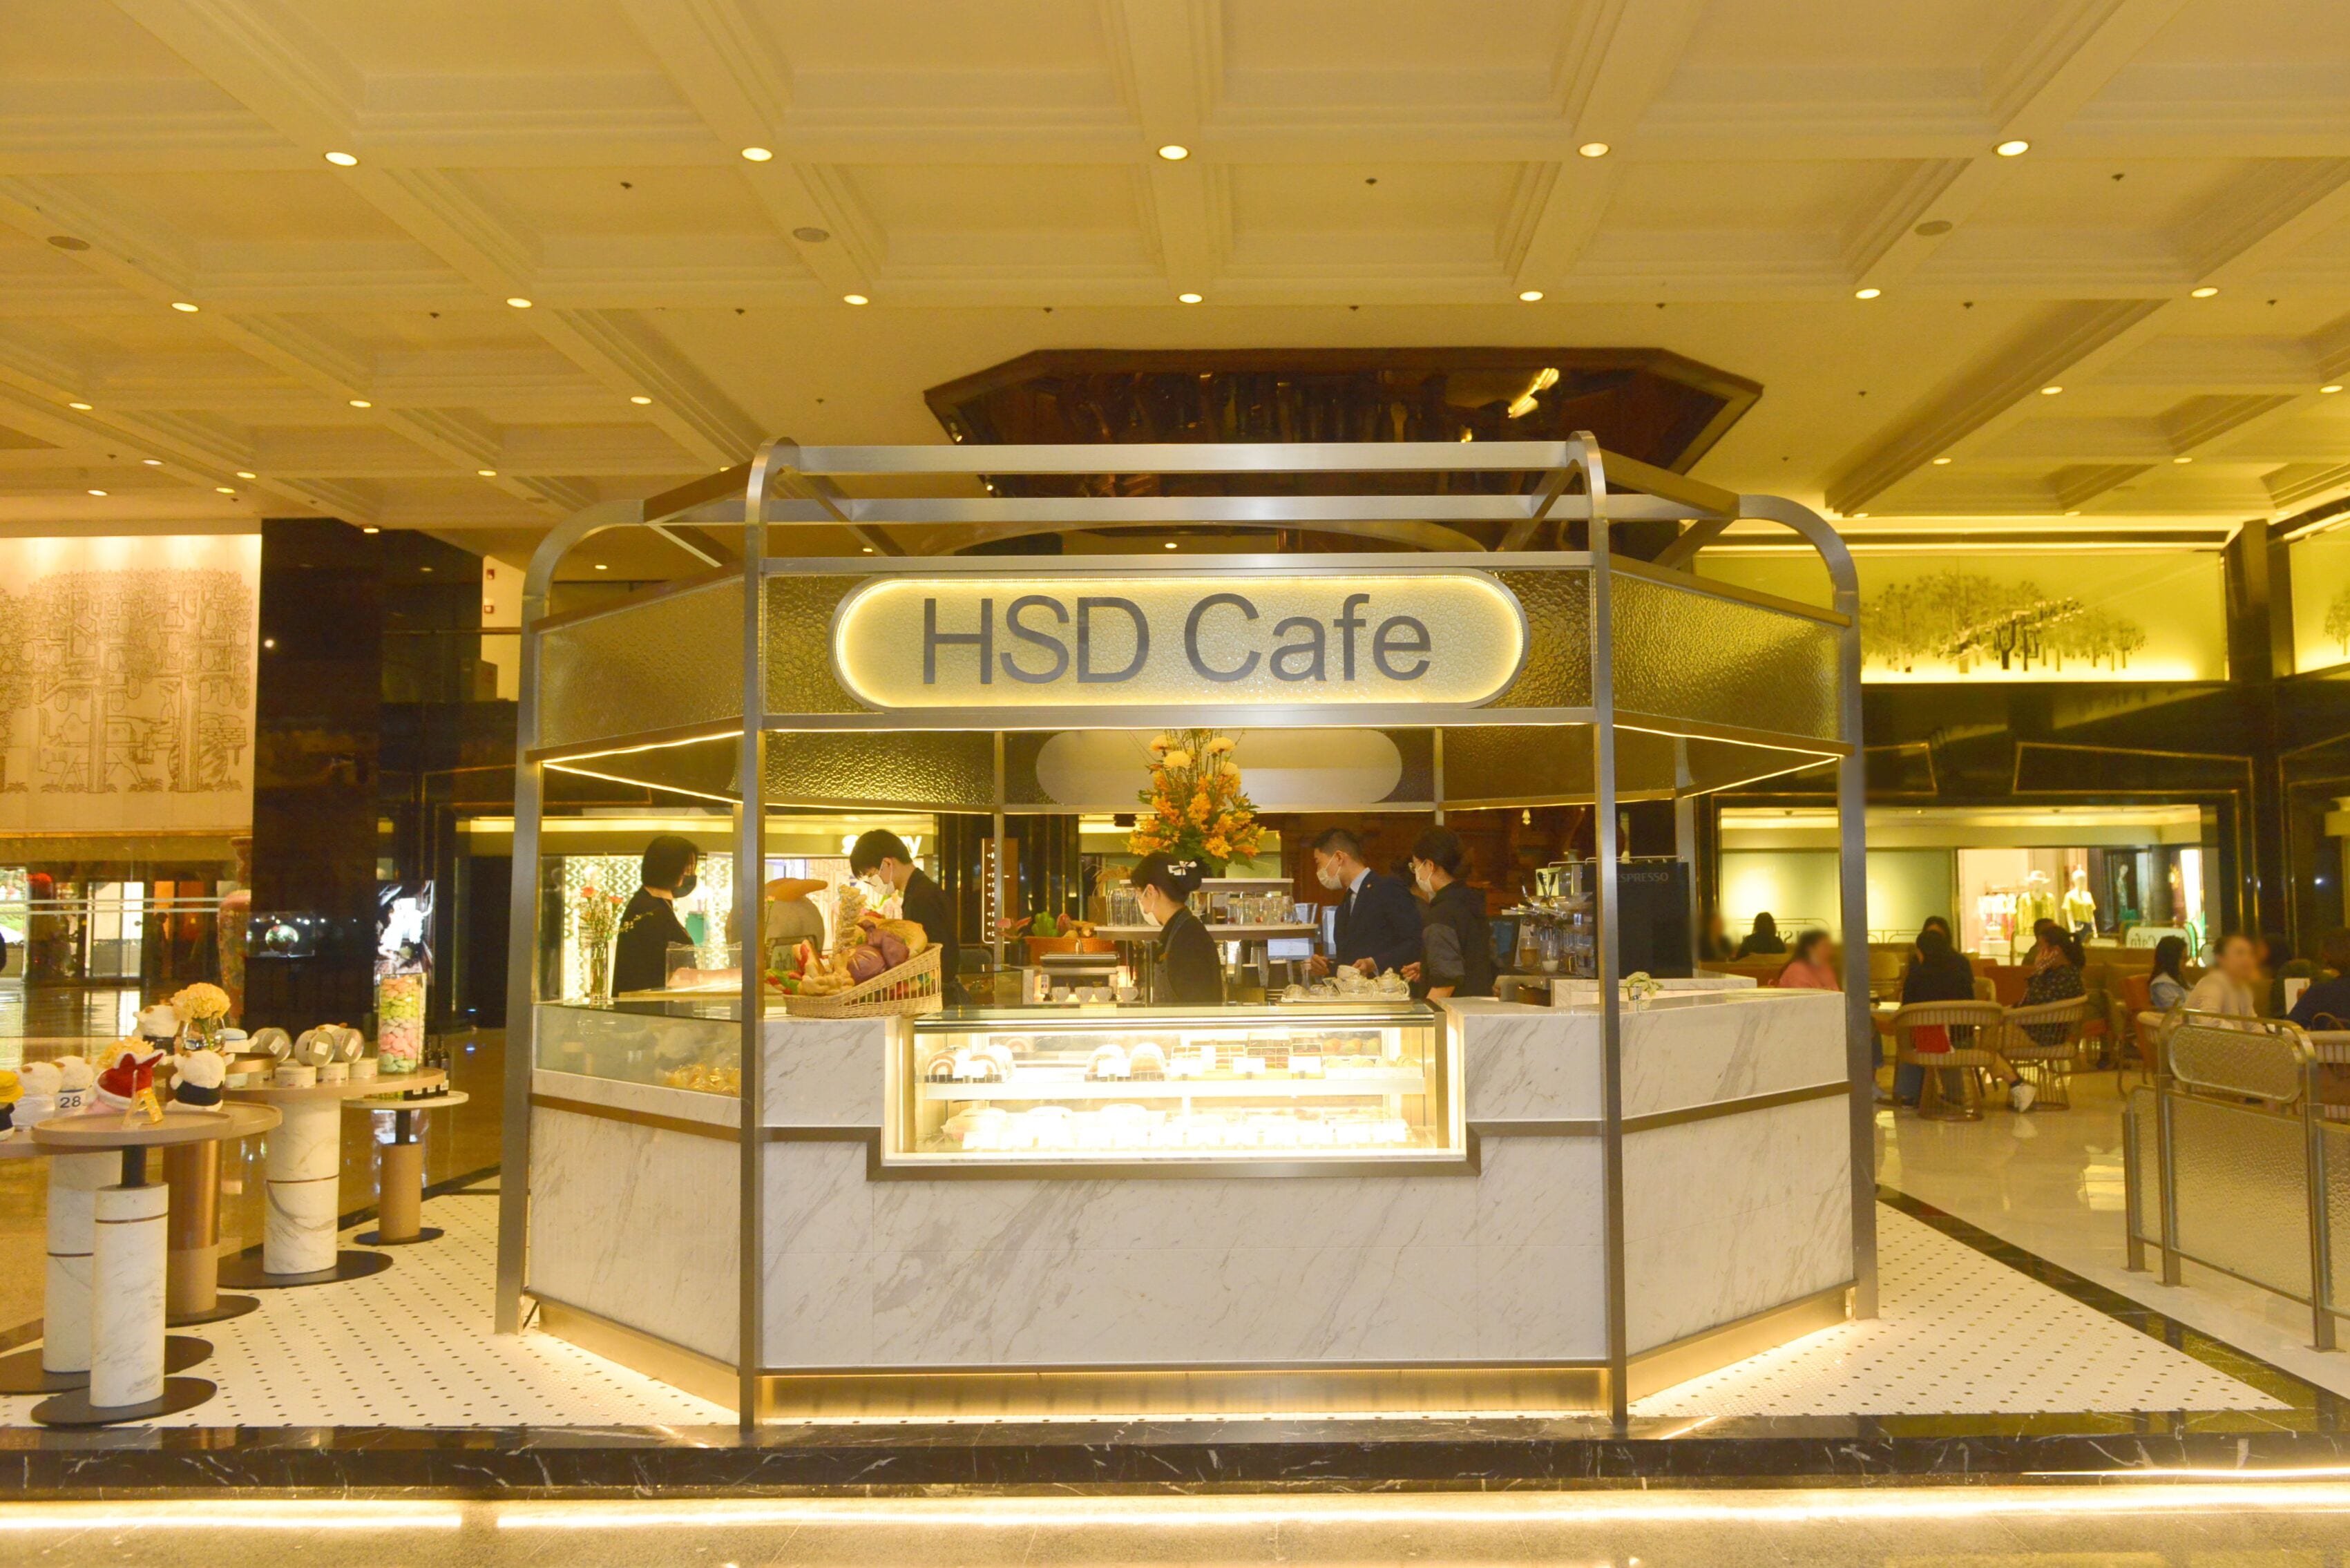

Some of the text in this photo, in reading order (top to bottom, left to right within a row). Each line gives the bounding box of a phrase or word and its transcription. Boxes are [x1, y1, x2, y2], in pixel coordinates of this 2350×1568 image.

[922, 593, 1432, 685] HSD Cafe
[59, 1096, 82, 1109] 28
